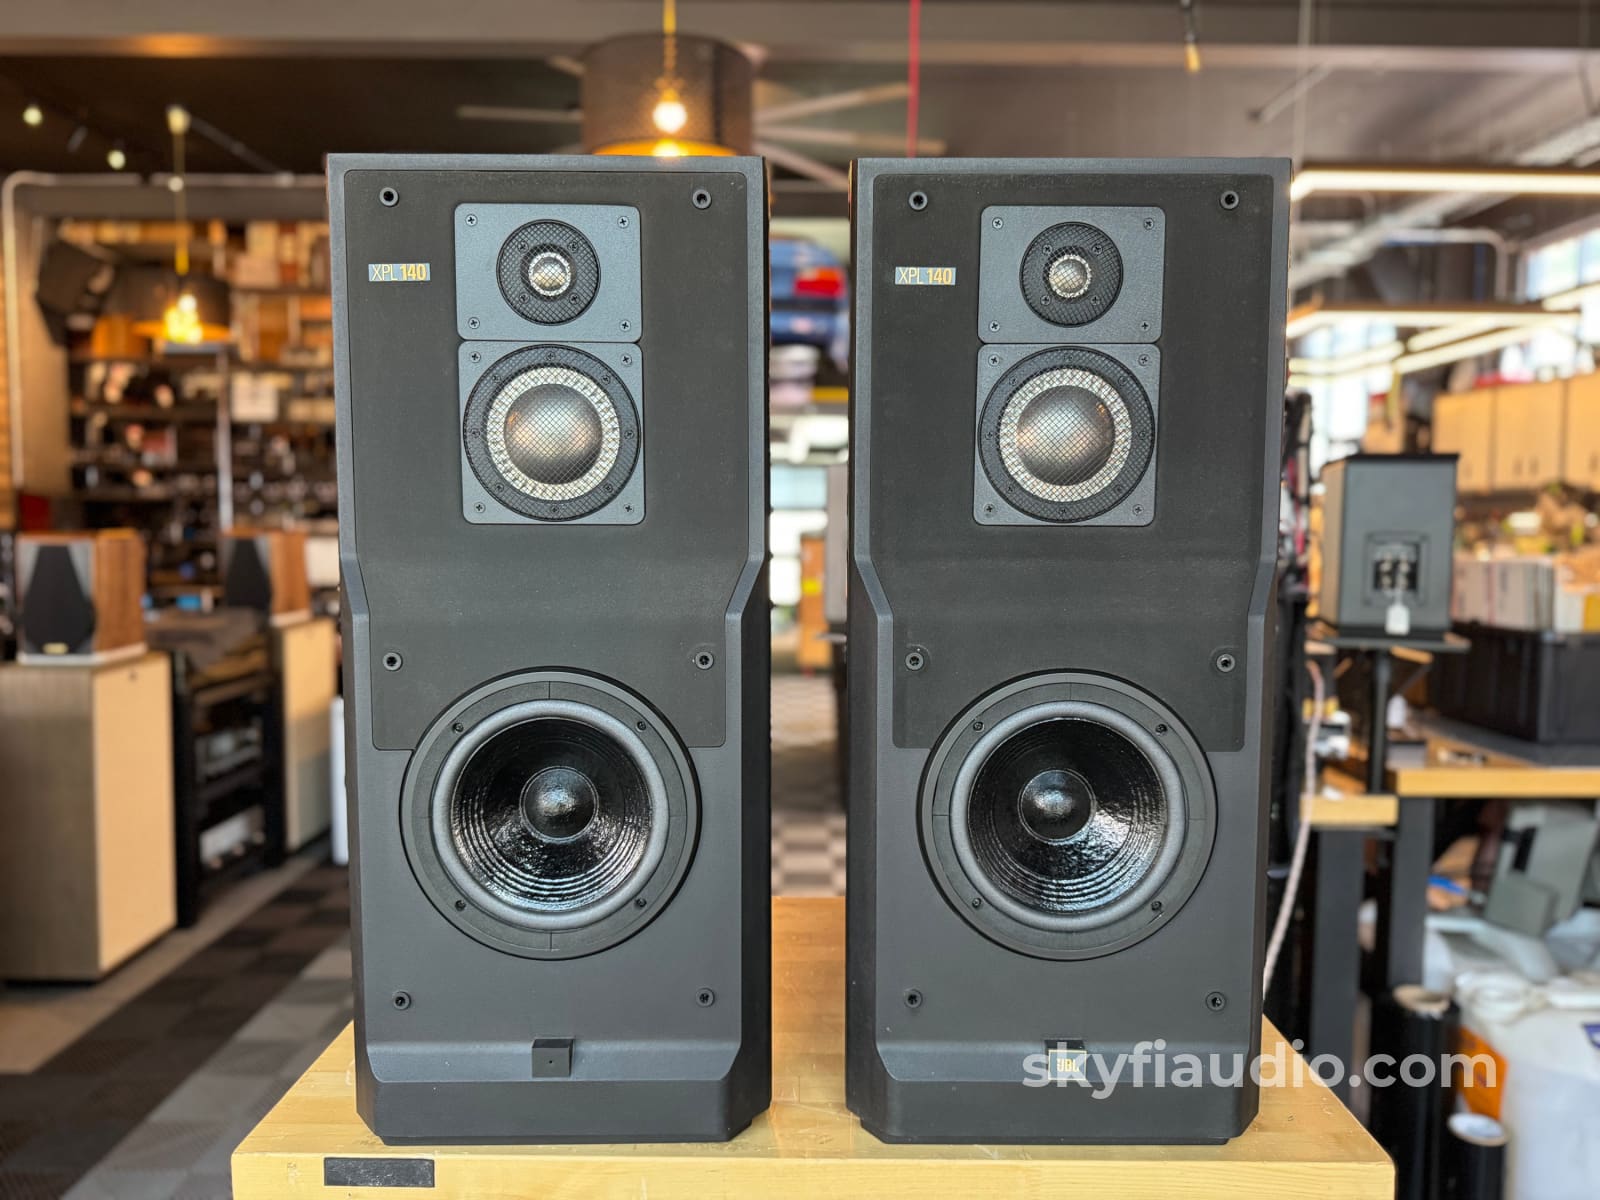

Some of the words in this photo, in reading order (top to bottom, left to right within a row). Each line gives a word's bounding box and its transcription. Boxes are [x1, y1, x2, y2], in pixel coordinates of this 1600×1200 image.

[371, 263, 398, 281] XPL
[400, 263, 426, 281] 140
[898, 267, 924, 285] XPL
[926, 267, 953, 285] 140
[1056, 1058, 1080, 1073] JBL
